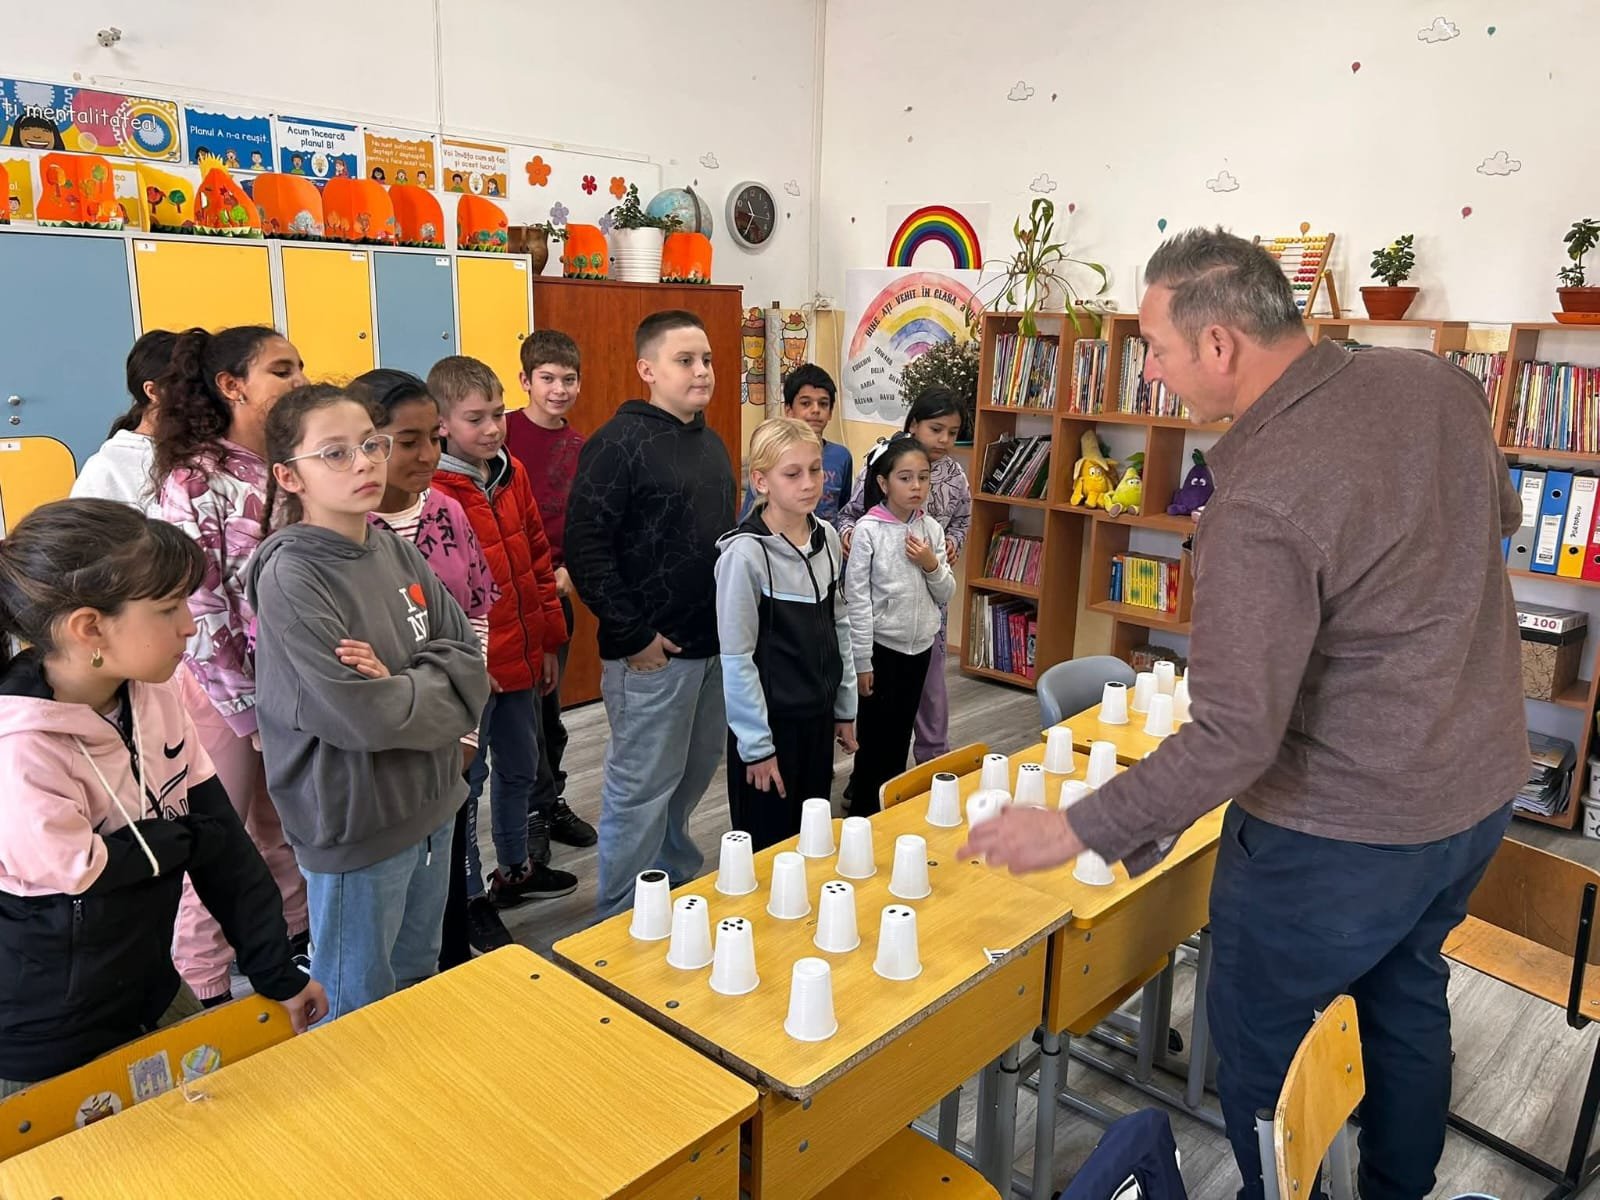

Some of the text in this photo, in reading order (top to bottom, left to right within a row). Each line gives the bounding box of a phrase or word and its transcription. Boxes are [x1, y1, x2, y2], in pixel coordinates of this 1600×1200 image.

[26, 104, 157, 132] mentalitatea!
[190, 125, 215, 137] Planul
[217, 129, 224, 137] A
[226, 132, 240, 140] n-a
[287, 125, 346, 141] Acum încearcă
[300, 138, 324, 148] planul
[934, 288, 957, 306] CLASA
[879, 393, 895, 401] DAVID
[398, 587, 417, 614] I
[1532, 617, 1557, 630] 100
